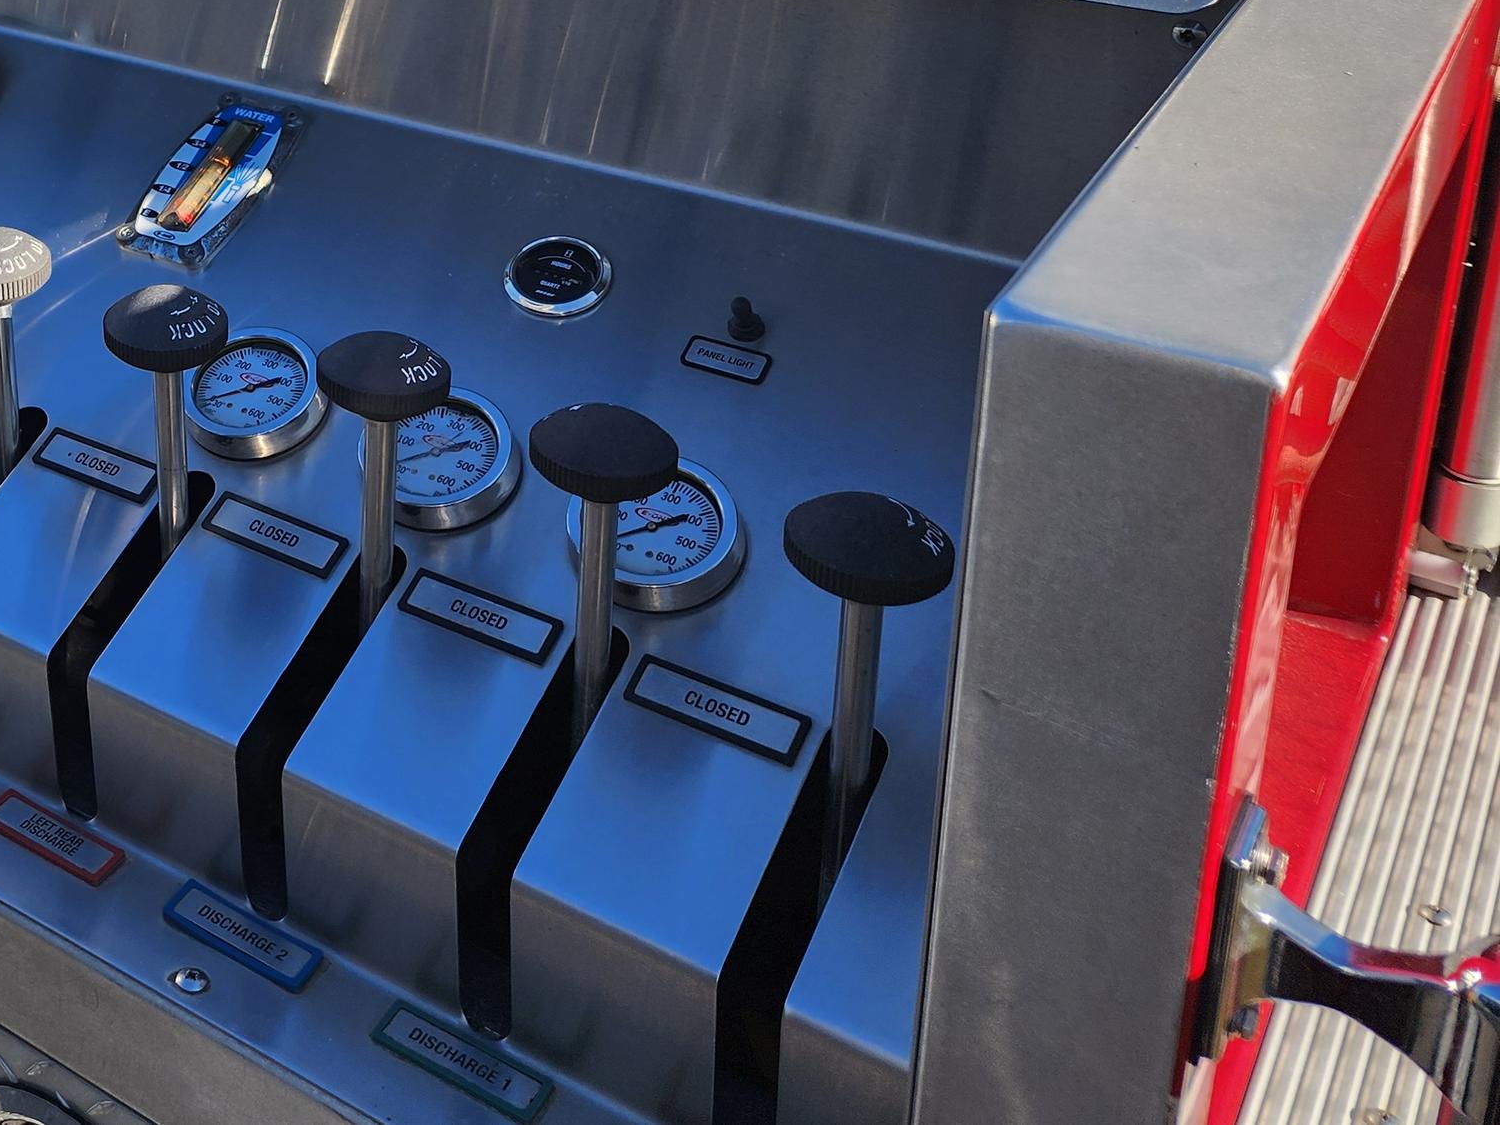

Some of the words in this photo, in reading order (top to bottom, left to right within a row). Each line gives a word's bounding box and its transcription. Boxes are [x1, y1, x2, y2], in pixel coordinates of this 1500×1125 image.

[234, 106, 276, 124] WATER
[235, 359, 252, 370] 200
[262, 358, 279, 369] 300
[696, 347, 726, 362] PANEL
[727, 354, 755, 370] LIGHT
[216, 373, 232, 384] 100
[266, 395, 283, 406] 500
[249, 408, 265, 419] 600
[416, 421, 435, 433] 200
[446, 420, 465, 432] 300
[74, 452, 120, 477] CLOSED
[456, 460, 475, 472] 500
[437, 475, 456, 487] 600
[661, 492, 681, 505] 300
[249, 519, 300, 548] CLOSED
[675, 536, 696, 549] 500
[656, 552, 677, 565] 600
[449, 599, 508, 630] CLOSED
[684, 690, 750, 726] CLOSED
[29, 813, 54, 831] LEFT
[56, 826, 84, 848] REAR
[20, 819, 80, 857] DISCHARGE
[198, 903, 277, 959] DISCHARGE
[275, 948, 289, 961] 2
[408, 1026, 499, 1084] DISCHARGE
[501, 1078, 514, 1091] 1
